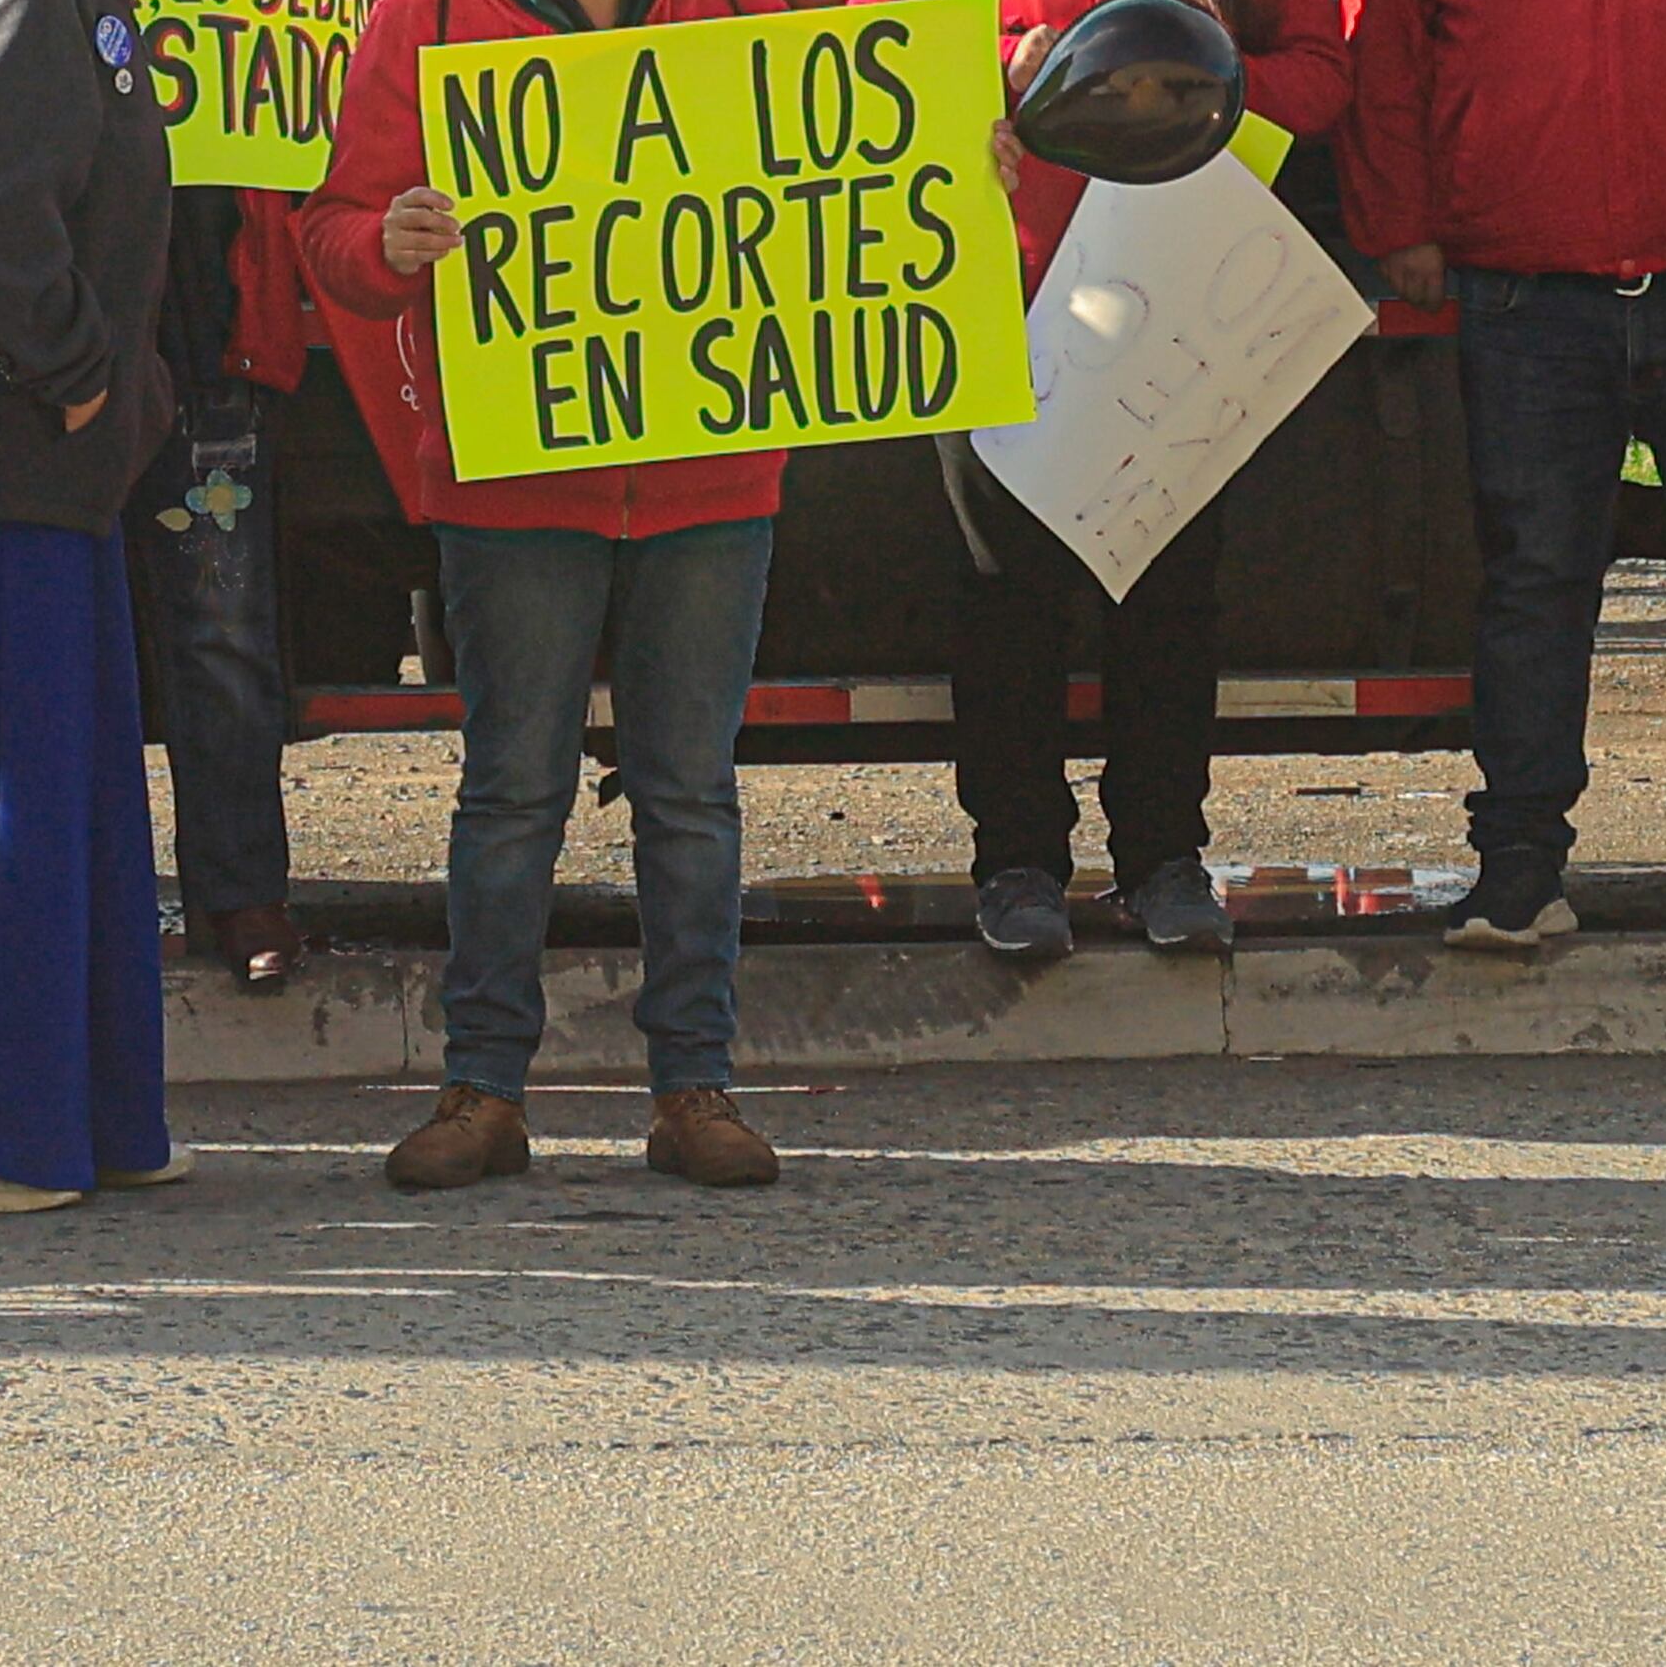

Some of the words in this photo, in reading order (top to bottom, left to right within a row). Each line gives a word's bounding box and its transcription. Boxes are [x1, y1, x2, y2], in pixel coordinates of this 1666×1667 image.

[142, 14, 352, 144] STADO
[444, 55, 564, 199] NO
[614, 49, 691, 184] A
[751, 18, 918, 179] LOS
[461, 164, 958, 345] RECORTES
[532, 331, 643, 451] EN
[690, 302, 959, 436] SALUD
